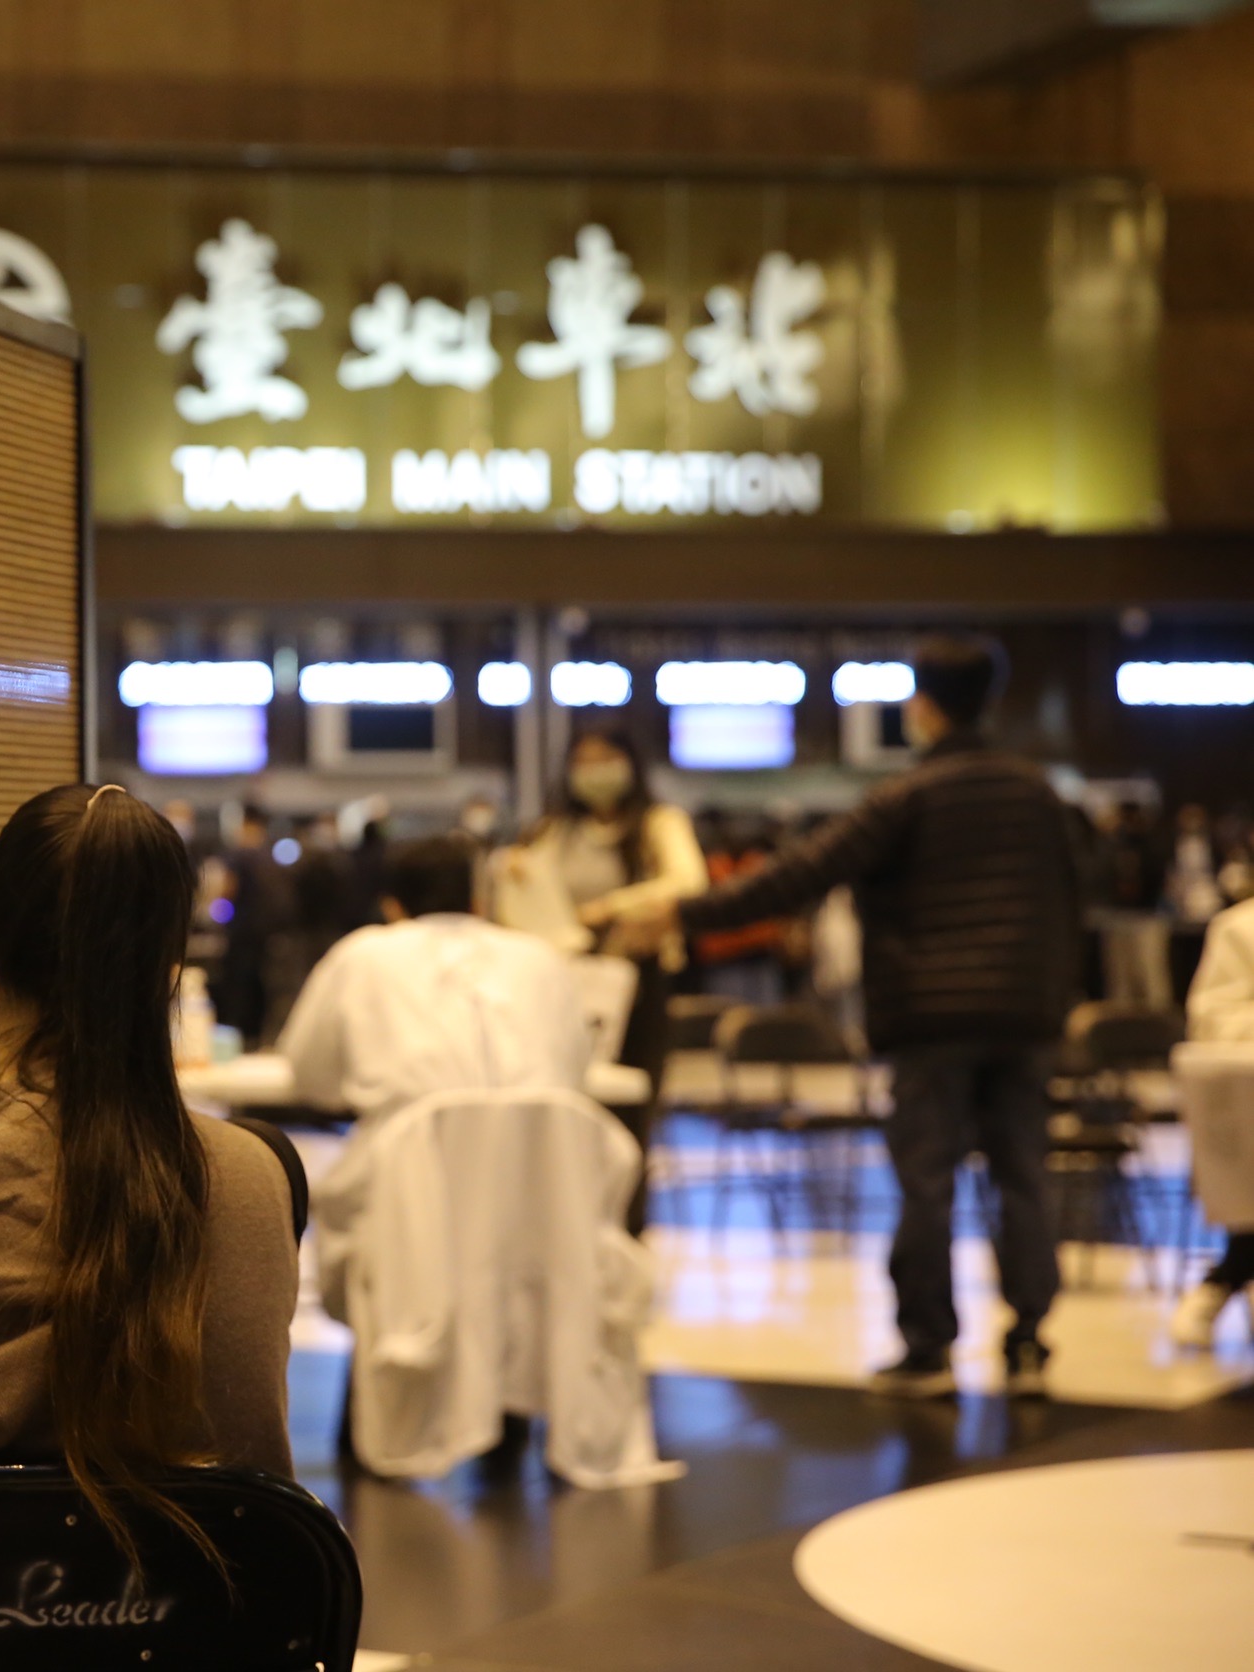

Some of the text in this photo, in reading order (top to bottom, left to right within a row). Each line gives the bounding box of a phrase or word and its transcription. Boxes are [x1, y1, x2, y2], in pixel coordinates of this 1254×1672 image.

[155, 216, 828, 440] 臺北車站
[171, 445, 823, 517] TAIPEI MAIN STATION
